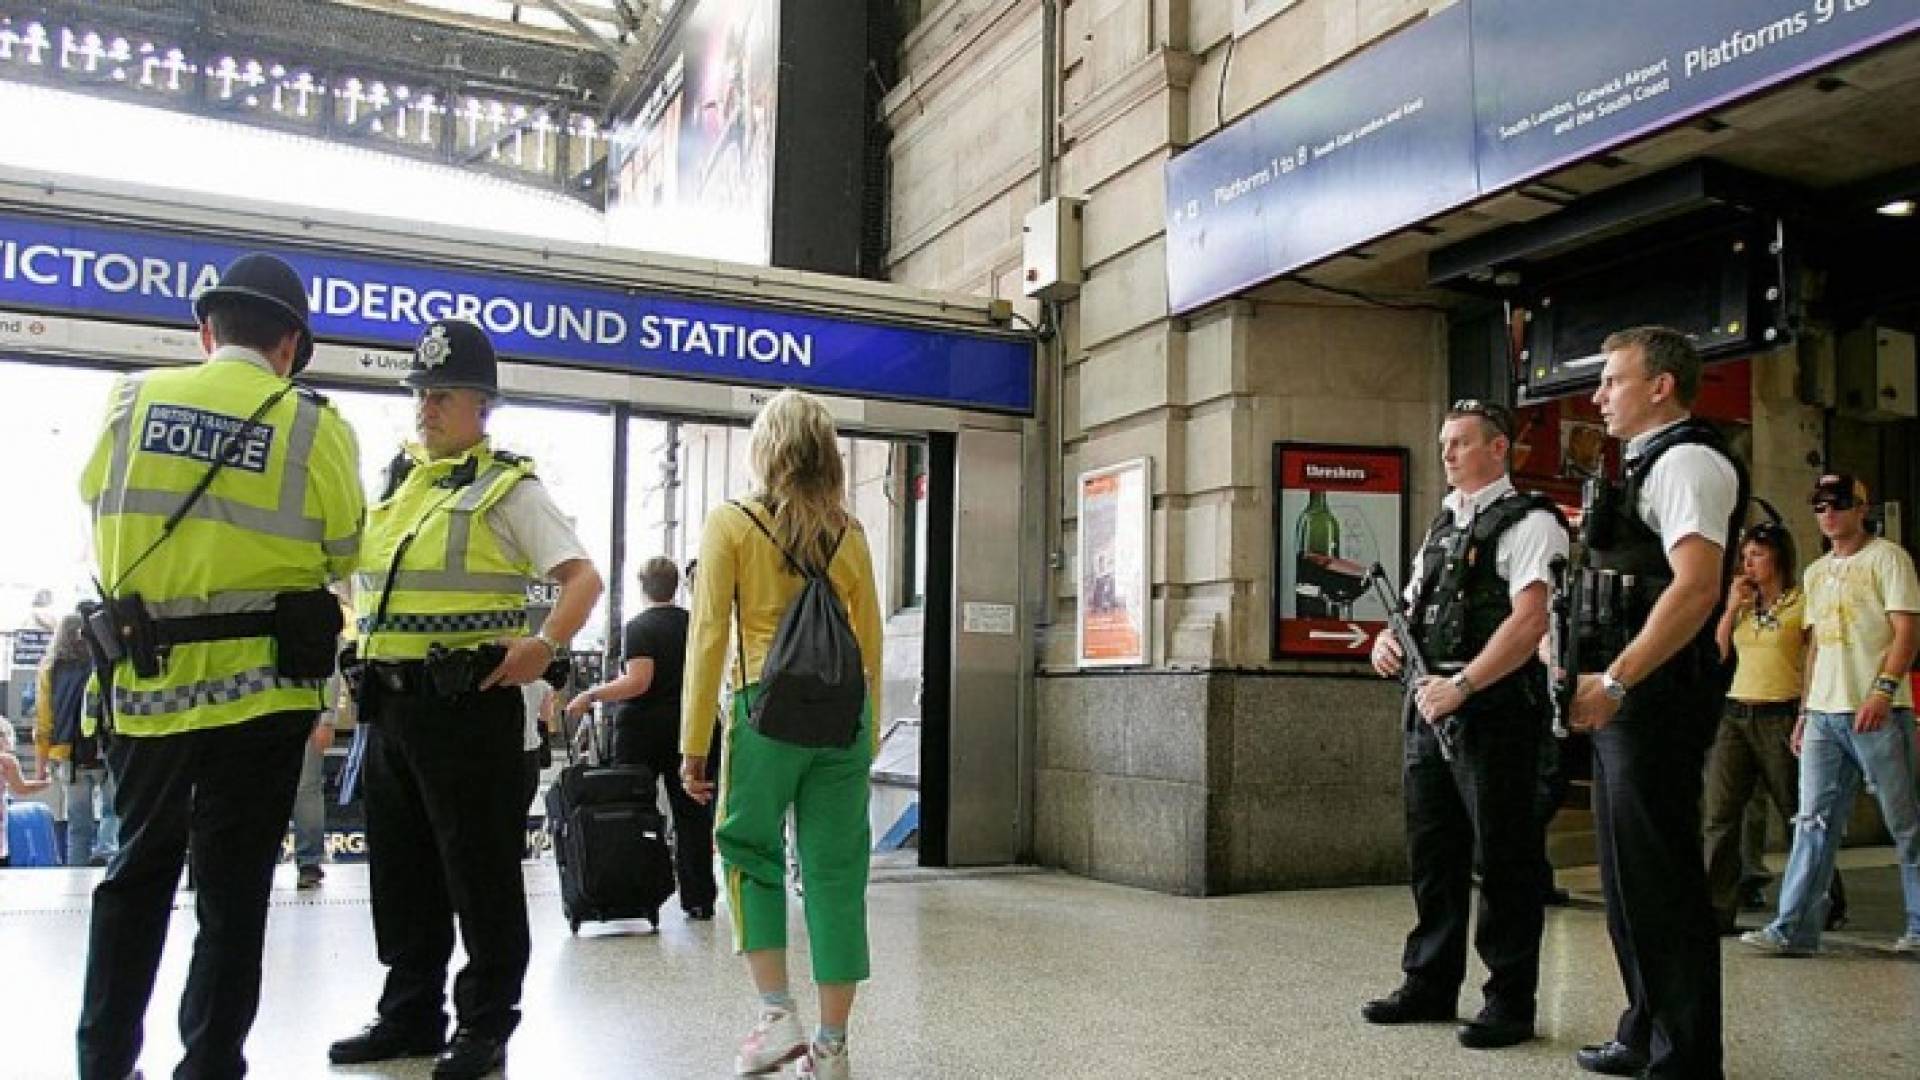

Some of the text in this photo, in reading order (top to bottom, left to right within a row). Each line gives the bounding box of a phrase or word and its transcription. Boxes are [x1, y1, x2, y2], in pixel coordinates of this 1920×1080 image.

[1684, 10, 1808, 79] Platforms
[1814, 0, 1834, 23] 9
[1625, 58, 1669, 87] Airport
[1214, 168, 1270, 208] Platforms
[1271, 158, 1278, 177] 1
[1280, 155, 1295, 174] to
[0, 239, 219, 300] ICTORIA
[640, 314, 812, 368] STATION
[145, 420, 266, 468] POLICE
